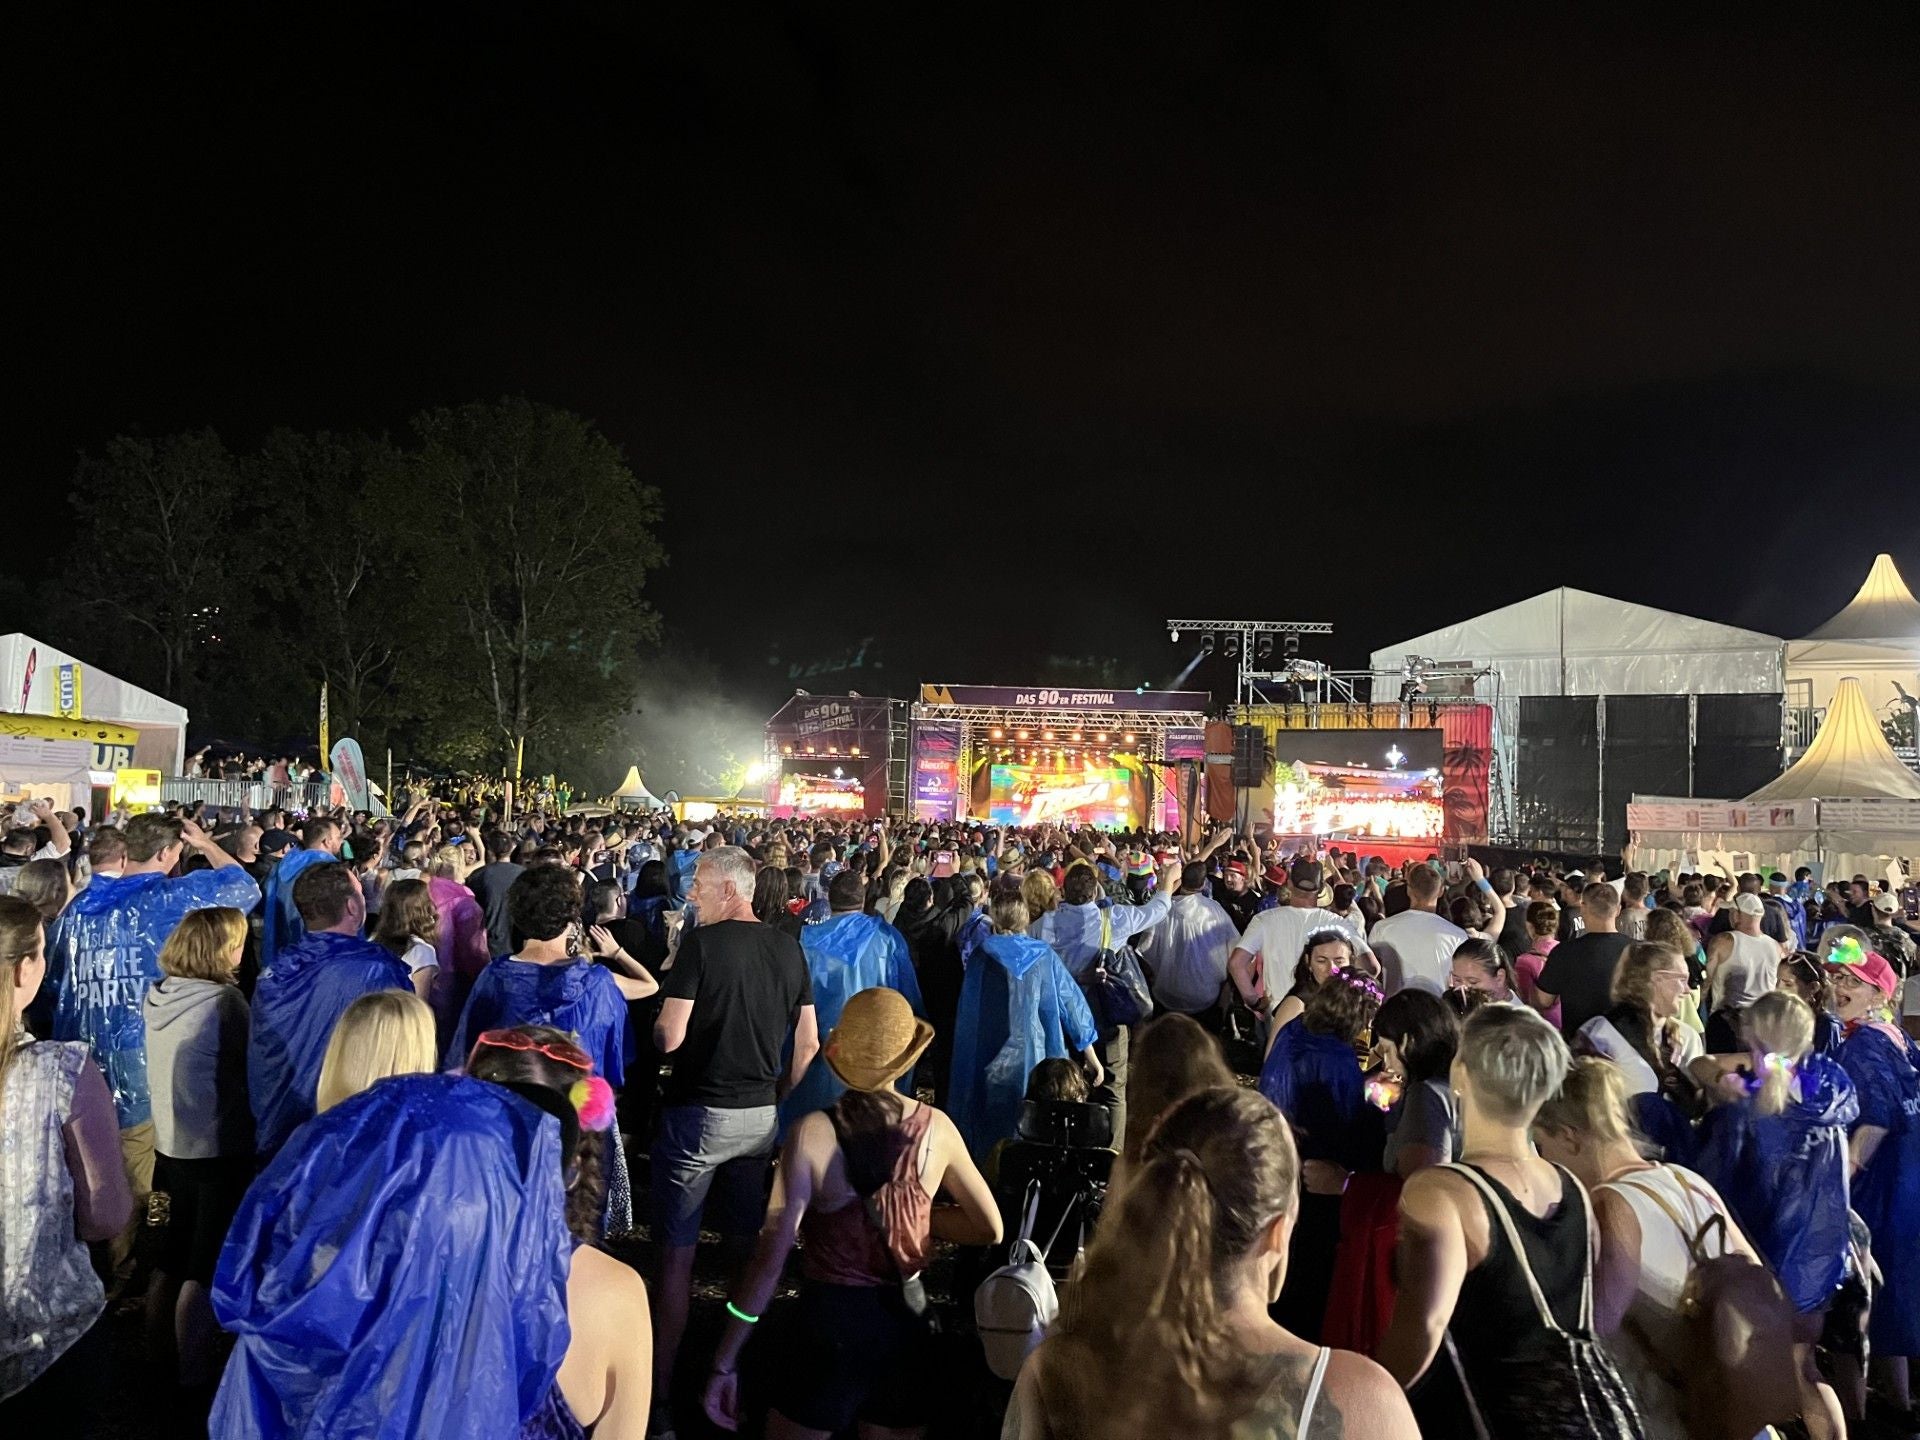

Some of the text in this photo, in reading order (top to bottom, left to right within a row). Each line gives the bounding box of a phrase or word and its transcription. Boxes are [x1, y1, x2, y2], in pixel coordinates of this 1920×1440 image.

[1015, 694, 1036, 705] DAS
[1070, 693, 1115, 705] FESTIVAL
[804, 708, 820, 718] DAS
[822, 713, 854, 729] FESTIVAL
[78, 977, 144, 1010] PARTY
